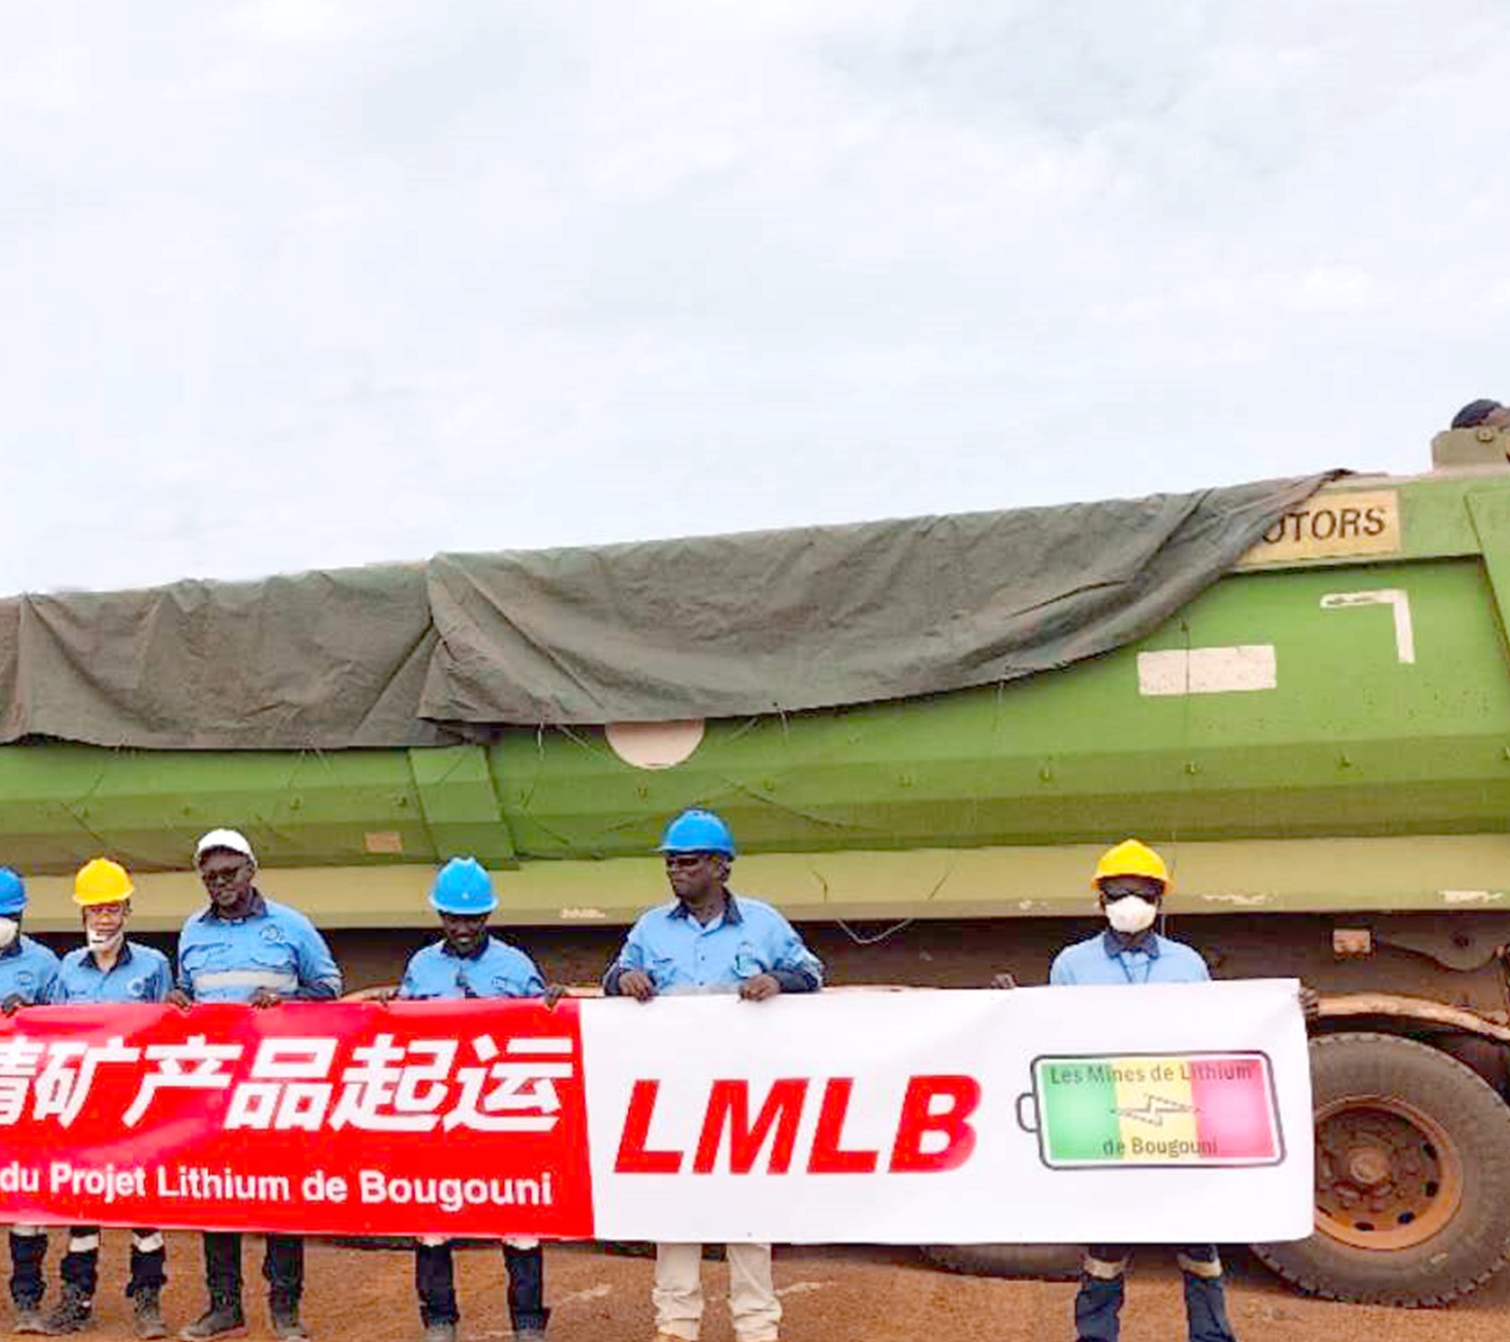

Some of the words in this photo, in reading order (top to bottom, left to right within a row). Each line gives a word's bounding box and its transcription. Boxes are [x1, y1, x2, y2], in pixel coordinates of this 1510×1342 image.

[1049, 1067, 1083, 1084] Les
[1089, 1065, 1145, 1083] Mines
[1151, 1064, 1175, 1081] de
[1180, 1062, 1253, 1081] Lithium
[613, 1074, 982, 1175] LMLB
[1102, 1139, 1126, 1156] de
[1131, 1137, 1218, 1159] Bougouni
[50, 1164, 146, 1198] Projet
[157, 1166, 290, 1201] Lithium
[302, 1170, 347, 1202] de
[359, 1172, 553, 1213] Bougouni
